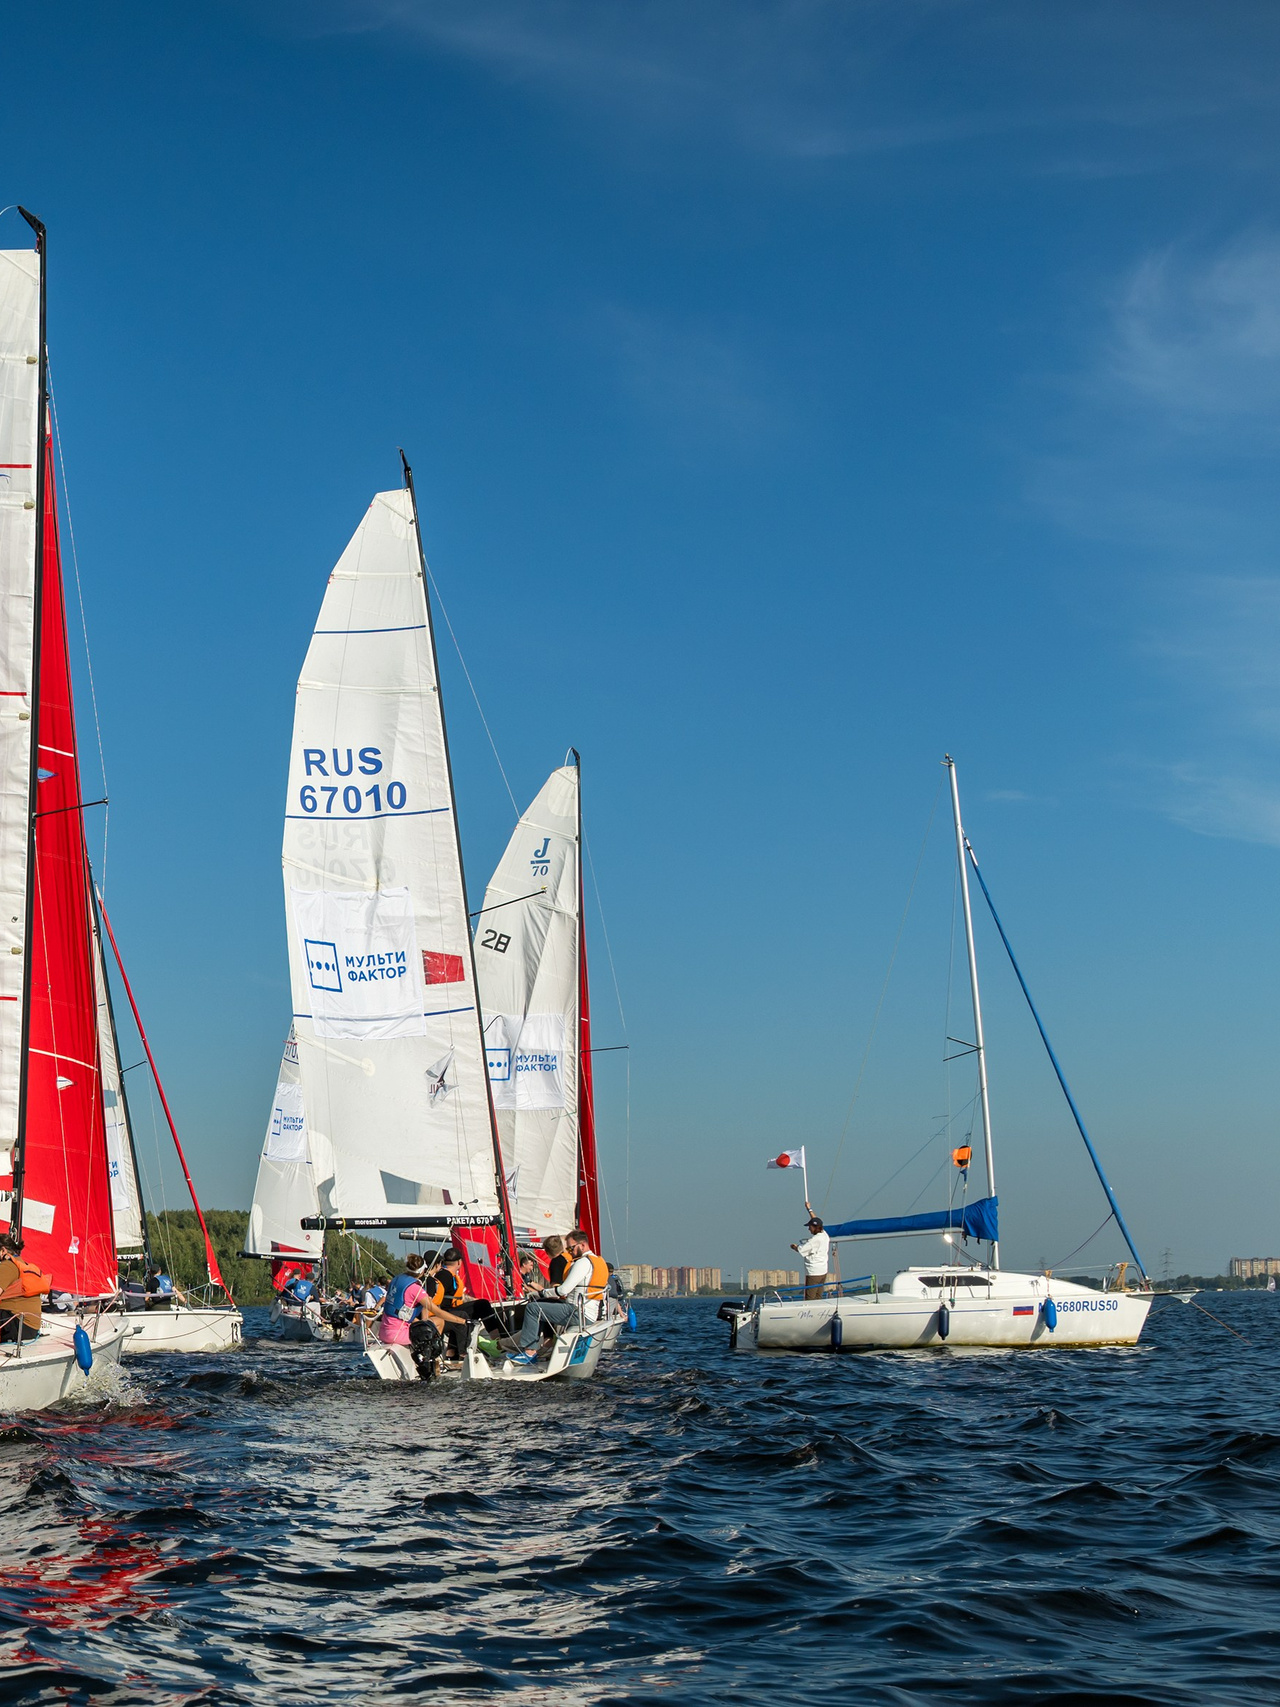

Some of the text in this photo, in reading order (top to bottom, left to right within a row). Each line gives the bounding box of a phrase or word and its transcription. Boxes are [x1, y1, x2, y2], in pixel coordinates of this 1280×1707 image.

[303, 747, 383, 777] RUS
[299, 781, 407, 814] 67010
[533, 837, 551, 858] J
[531, 865, 549, 877] 70
[345, 951, 406, 968] МУЛЬТИ
[348, 966, 407, 982] ФАКТОР
[516, 1054, 557, 1063] МУЛЬТИ
[516, 1063, 557, 1071] ФАКТОР
[354, 1218, 387, 1226] moresail.ru
[1056, 1299, 1118, 1313] 5680RUS50
